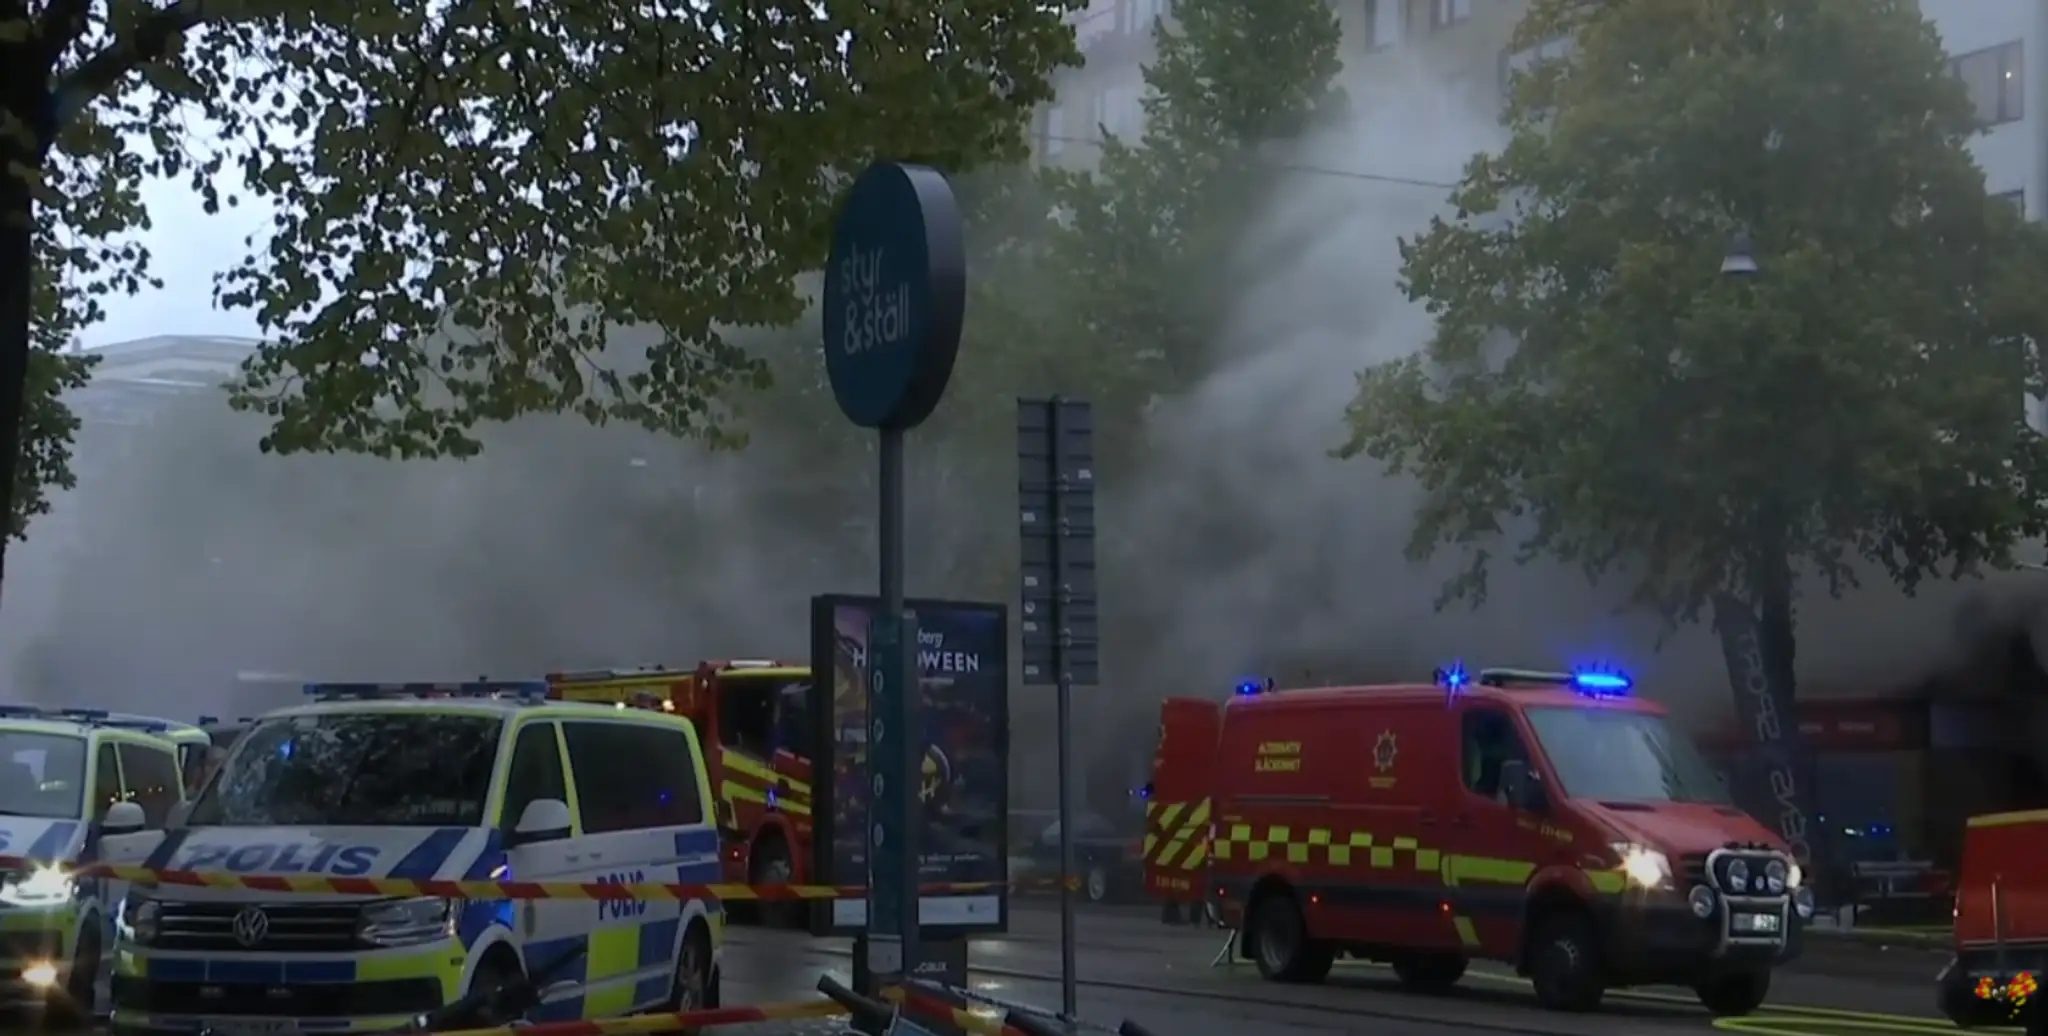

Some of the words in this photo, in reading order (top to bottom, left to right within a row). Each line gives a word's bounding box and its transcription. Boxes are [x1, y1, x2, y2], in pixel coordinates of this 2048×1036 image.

[841, 242, 883, 306] styr
[844, 282, 910, 355] &ställ
[918, 627, 943, 649] berg
[181, 844, 381, 876] POLIS
[597, 870, 646, 921] POLIS
